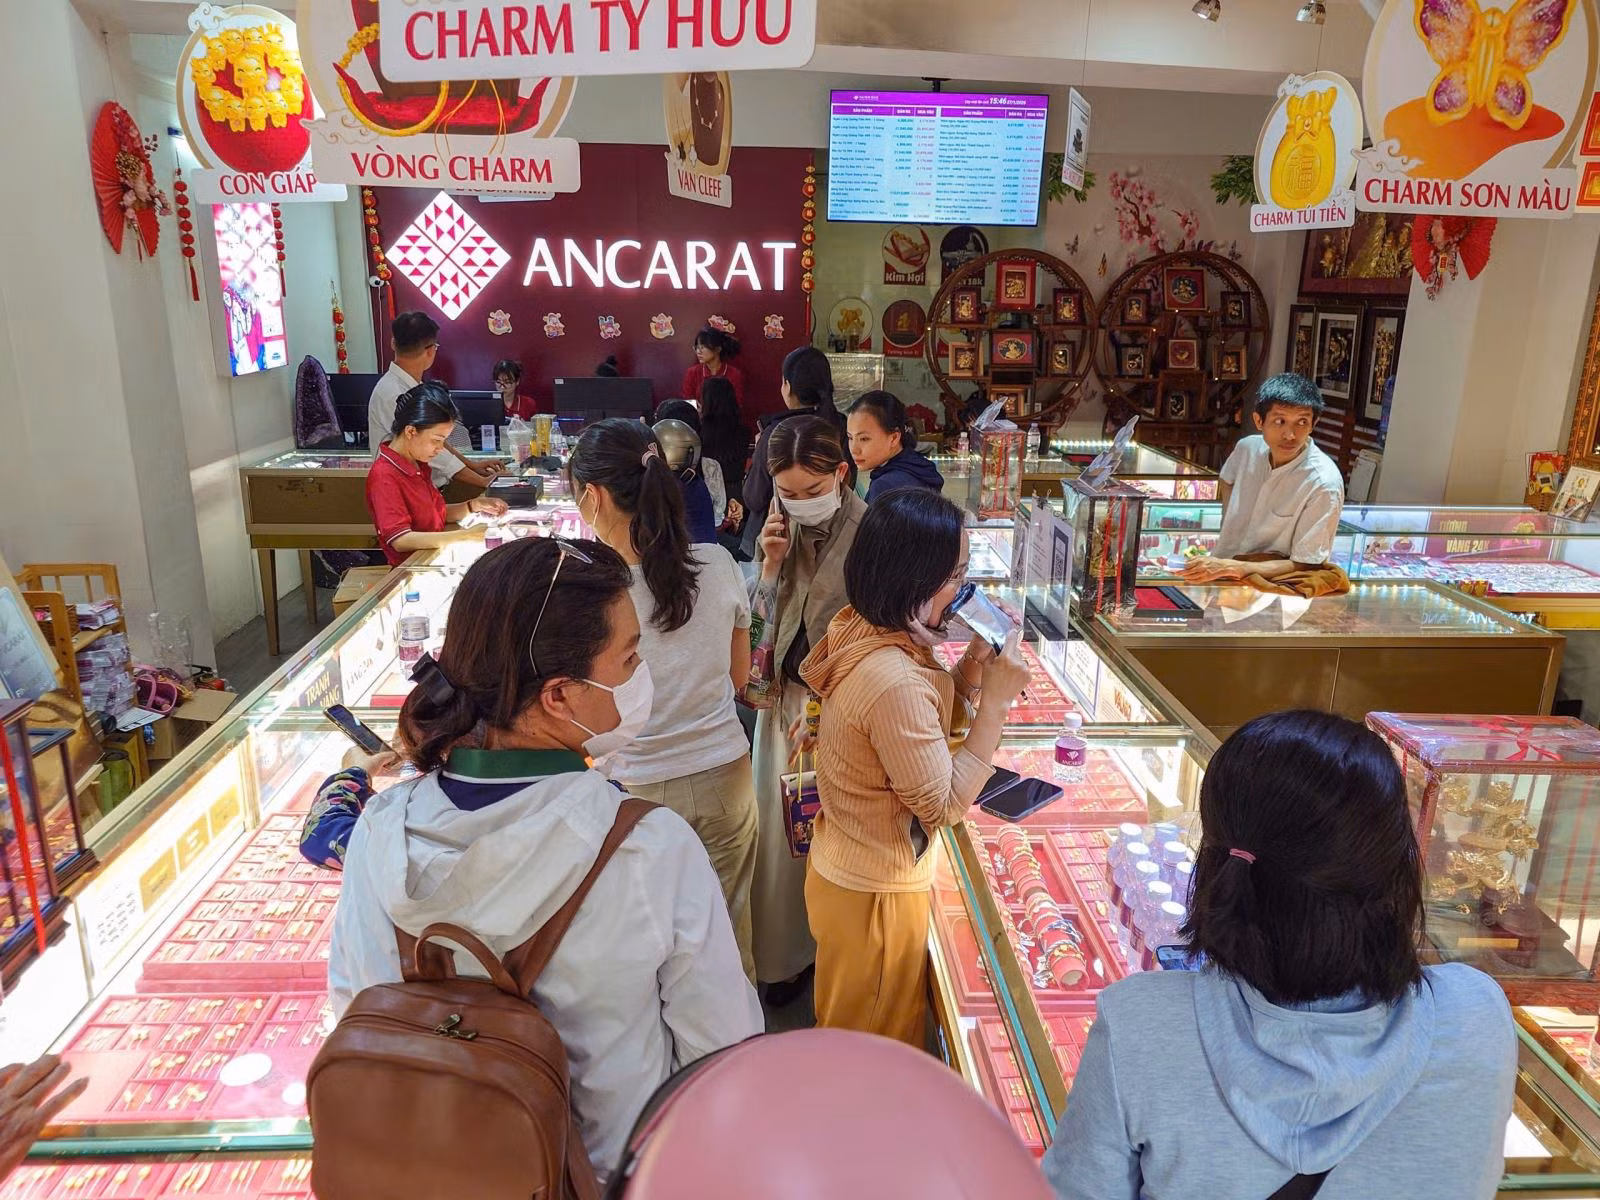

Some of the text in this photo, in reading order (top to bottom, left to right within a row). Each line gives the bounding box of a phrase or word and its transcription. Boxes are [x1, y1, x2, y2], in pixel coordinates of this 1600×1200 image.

[405, 3, 575, 61] CHARM
[990, 97, 1007, 105] 15:46
[351, 144, 553, 184] VÒNG CHARM
[219, 166, 317, 195] CON GIÁP
[677, 168, 722, 198] VAN CLEEF
[1363, 178, 1571, 211] CHARM SƠN MÀU
[1254, 200, 1347, 227] CHARM TÚI TIỀN
[523, 238, 797, 291] ANCARAT
[886, 272, 925, 285] Kim Hợi
[1446, 537, 1471, 553] VÀNG
